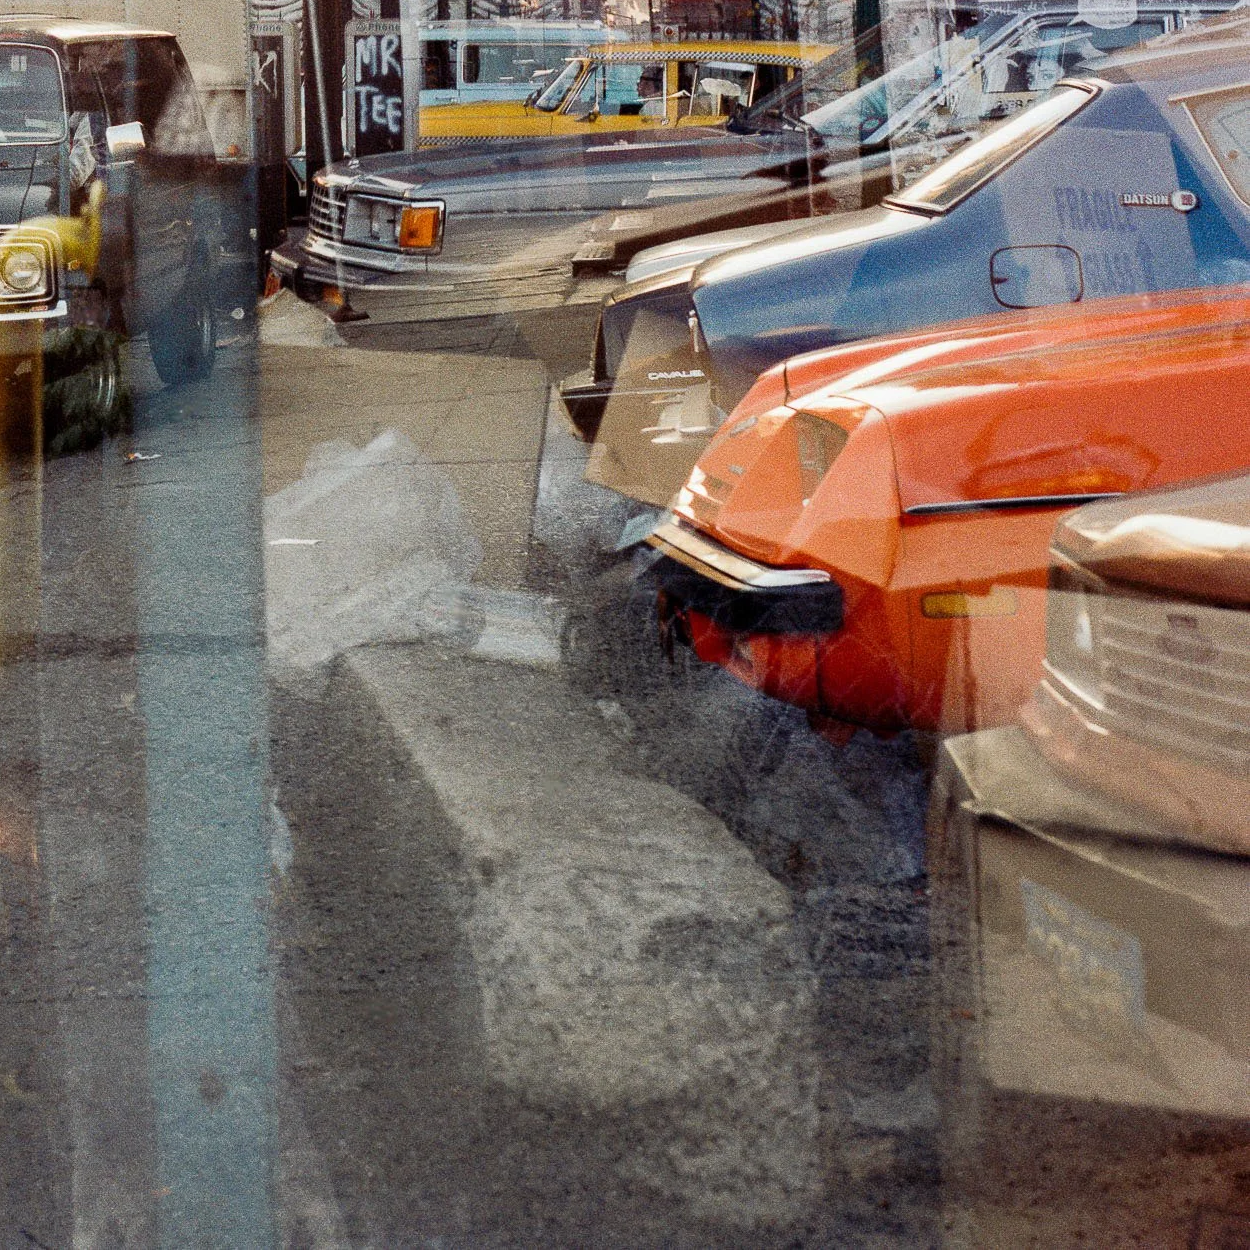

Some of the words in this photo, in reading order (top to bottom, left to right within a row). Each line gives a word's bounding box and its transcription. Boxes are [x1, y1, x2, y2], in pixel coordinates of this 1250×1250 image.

[368, 22, 400, 33] Phone
[355, 36, 401, 83] MR
[355, 85, 402, 133] TEE
[1123, 194, 1169, 205] DATSUN
